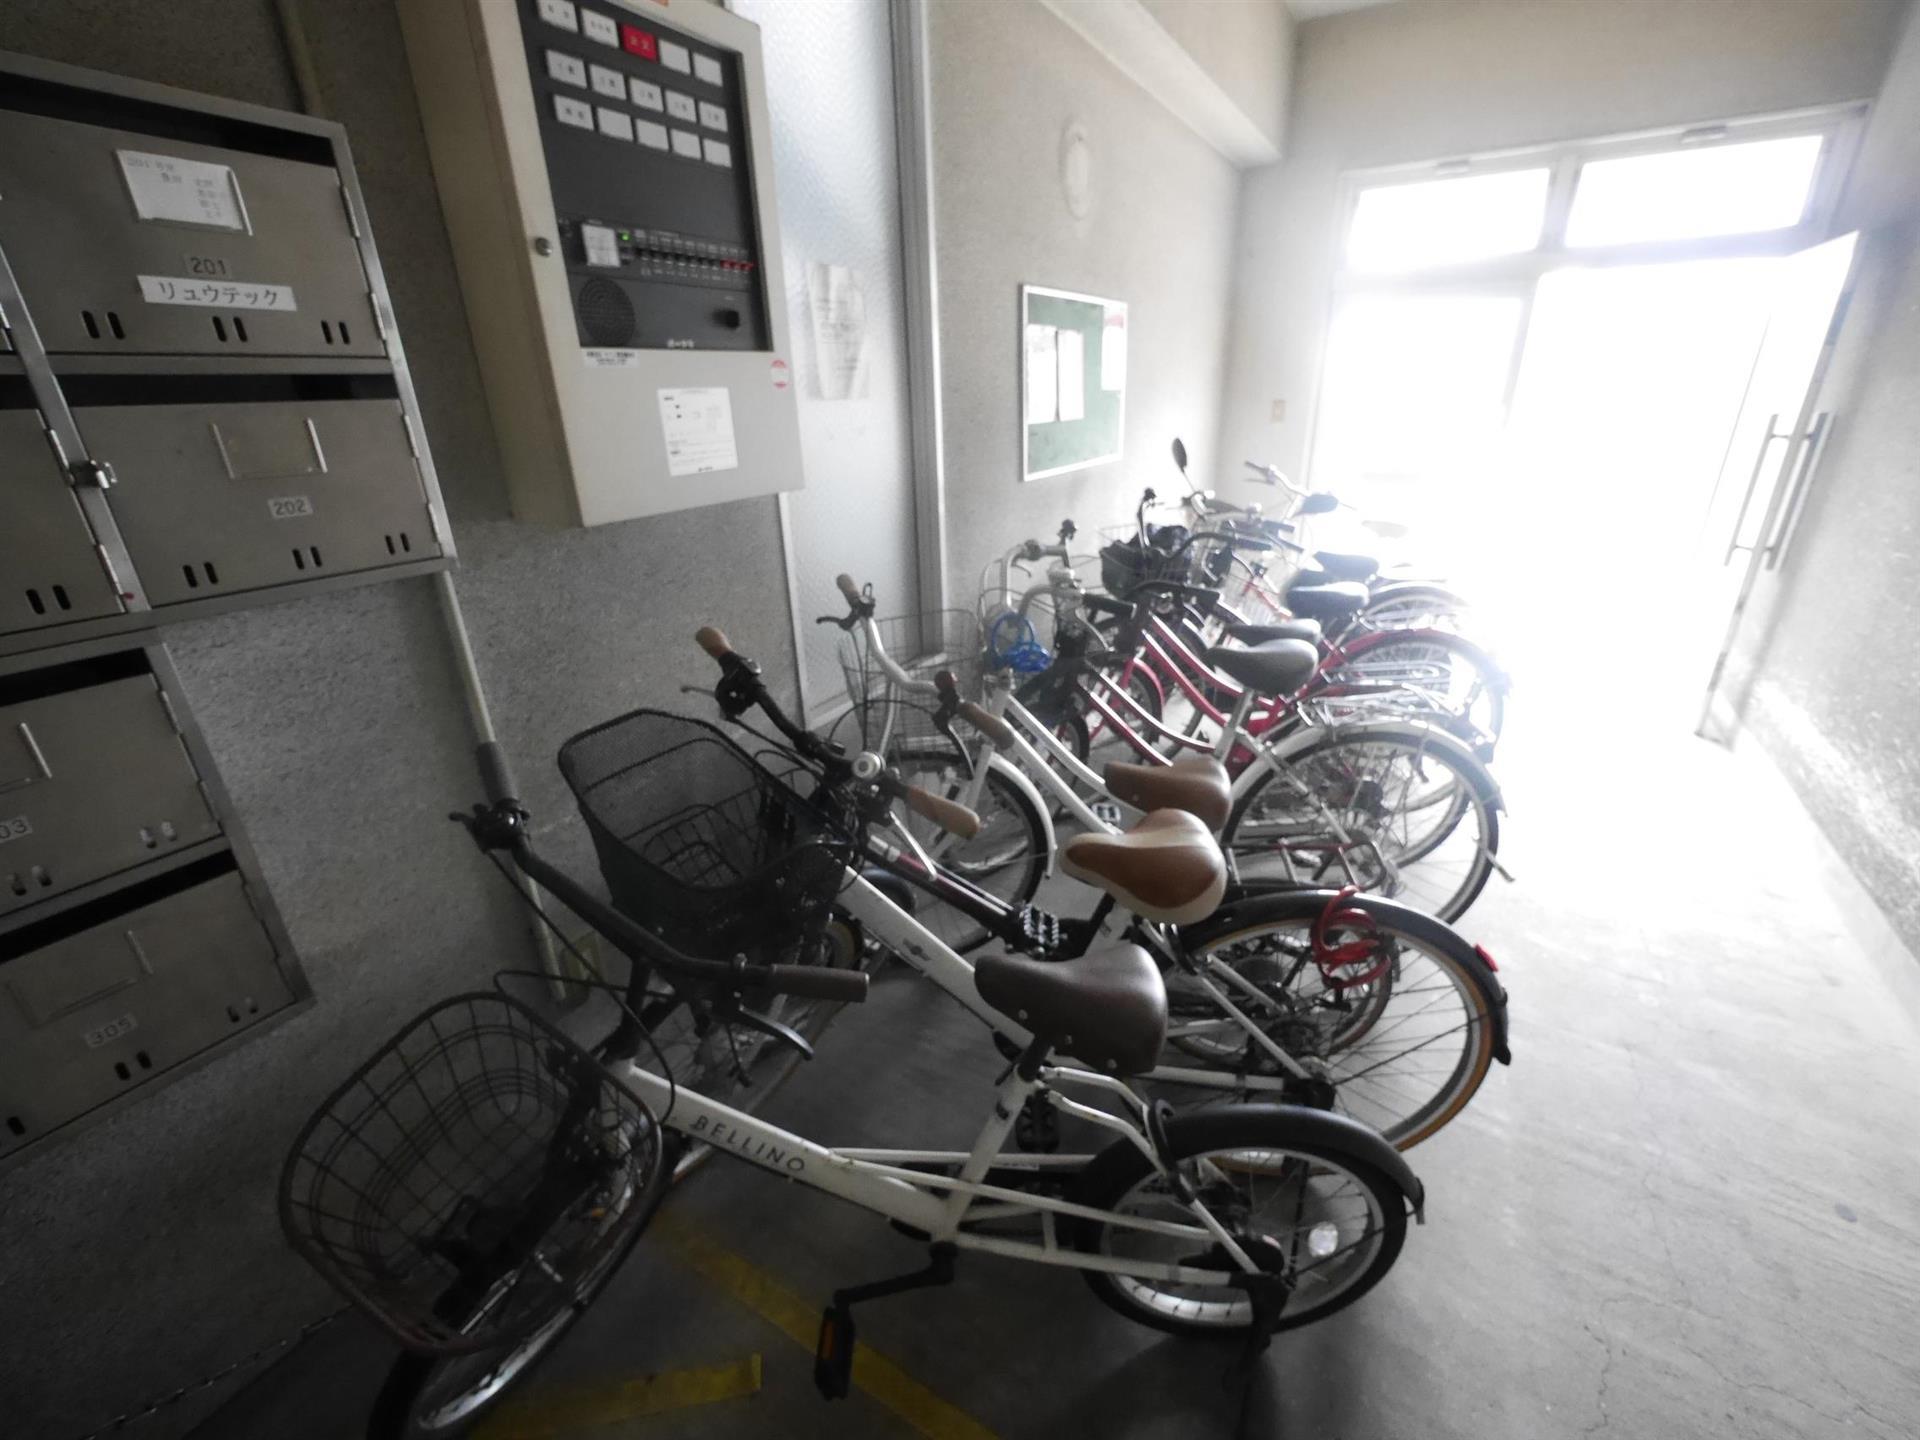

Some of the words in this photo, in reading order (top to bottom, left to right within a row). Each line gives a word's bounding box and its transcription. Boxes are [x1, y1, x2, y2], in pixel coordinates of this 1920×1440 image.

[190, 257, 226, 275] 201
[158, 282, 277, 306] リュウテック
[274, 499, 307, 515] 202
[689, 1115, 805, 1171] BELLINO
